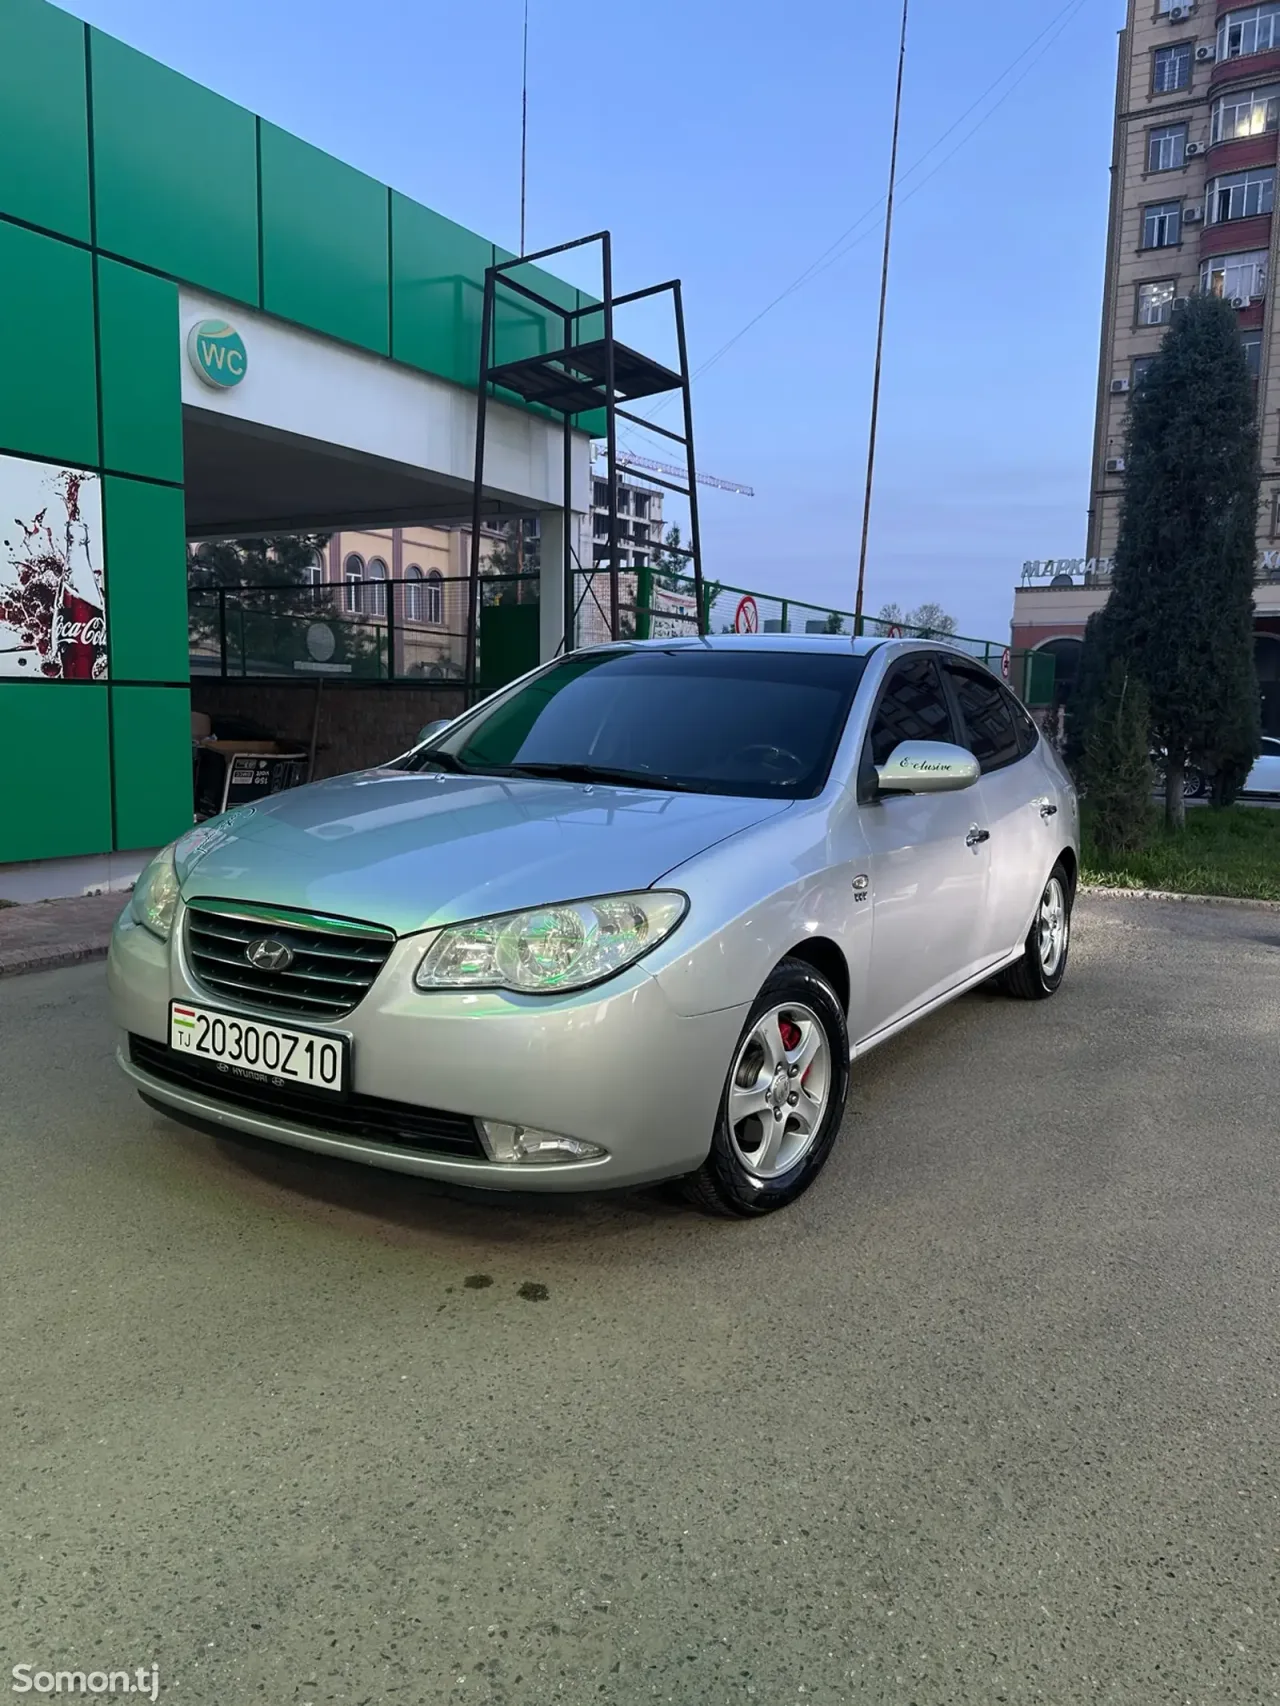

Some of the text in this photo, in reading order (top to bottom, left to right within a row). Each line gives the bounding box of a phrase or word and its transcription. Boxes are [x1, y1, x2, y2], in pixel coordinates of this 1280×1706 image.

[201, 340, 243, 375] WC
[899, 756, 953, 771] Eclusive
[178, 1031, 191, 1047] TJ
[233, 1066, 268, 1083] HYUNDAI
